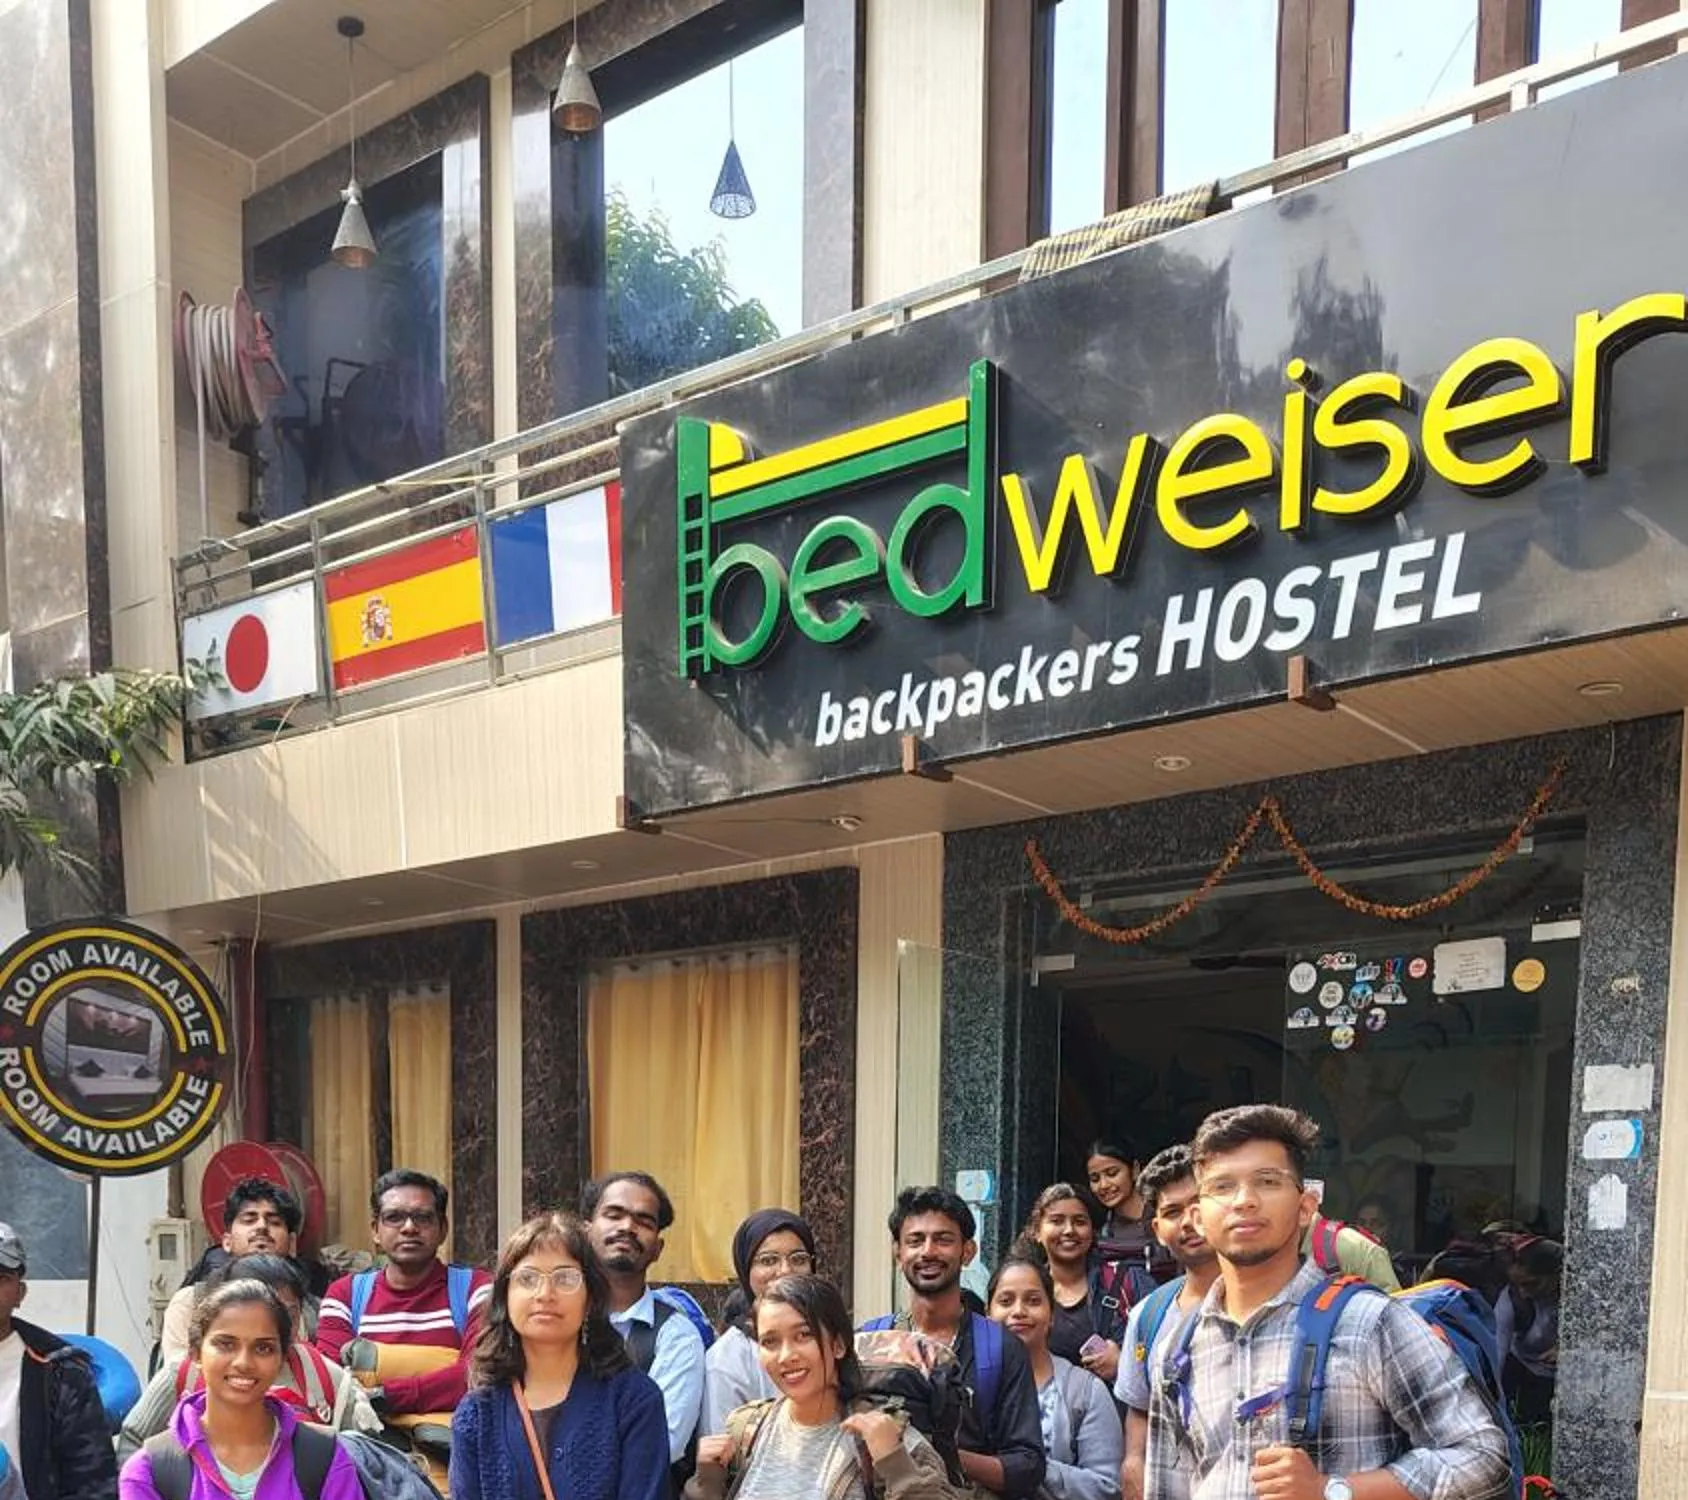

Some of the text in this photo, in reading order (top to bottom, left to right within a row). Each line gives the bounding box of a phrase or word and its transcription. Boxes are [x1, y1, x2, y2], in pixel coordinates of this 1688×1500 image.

[815, 532, 1482, 748] backpackers HOSTEL
[4, 943, 209, 1047] ROOM AVAILABLE
[0, 1047, 209, 1154] ROOM AVAILABLE
